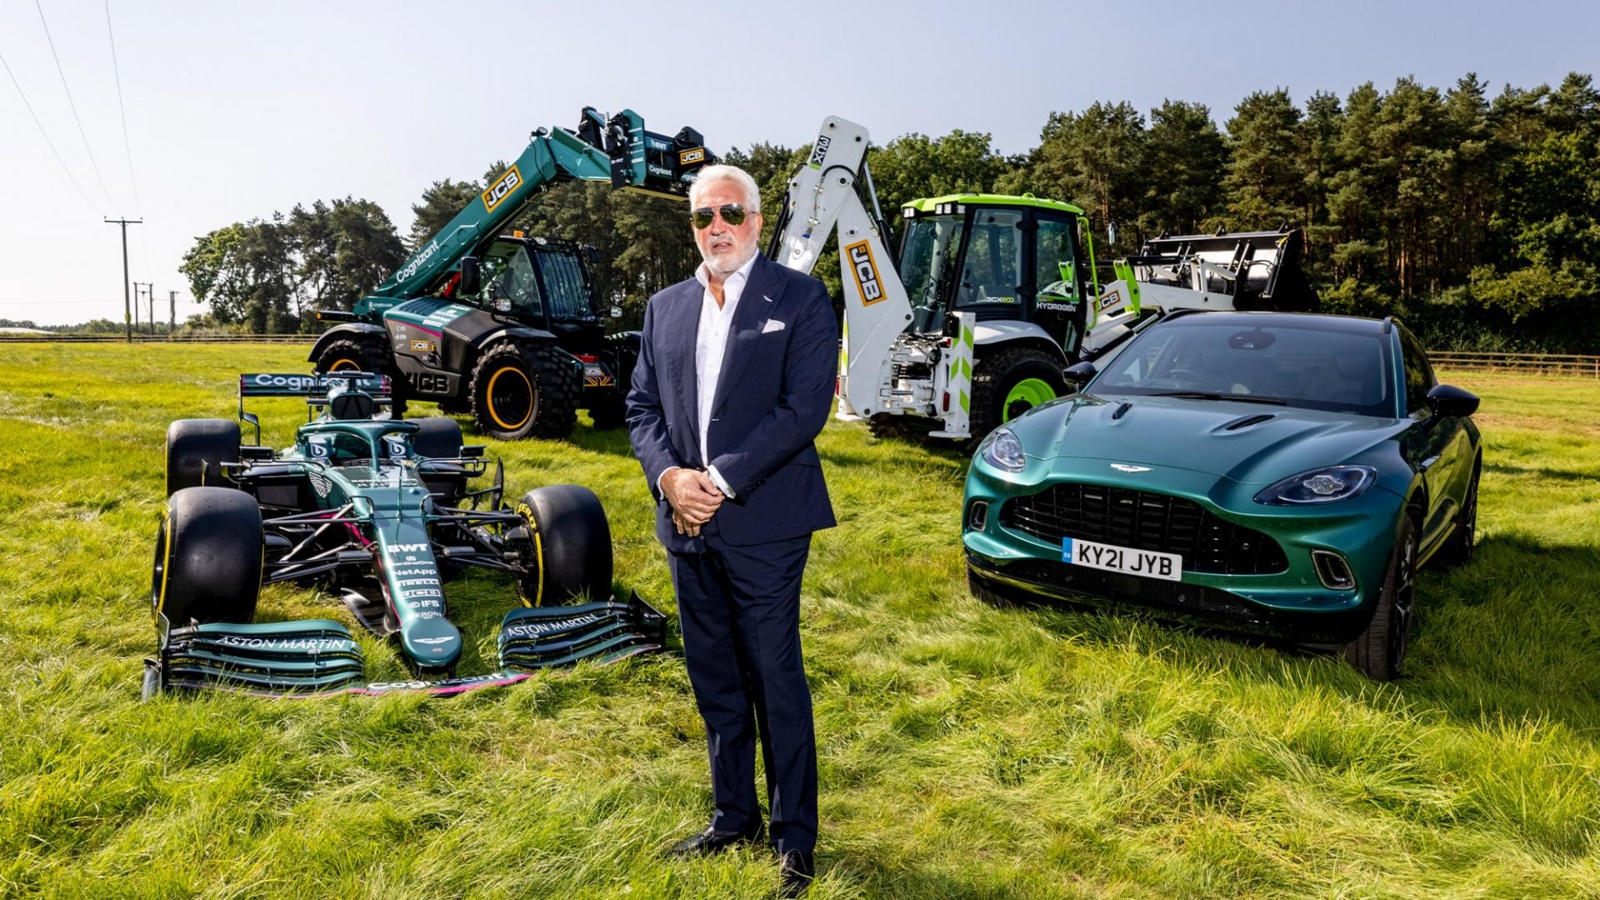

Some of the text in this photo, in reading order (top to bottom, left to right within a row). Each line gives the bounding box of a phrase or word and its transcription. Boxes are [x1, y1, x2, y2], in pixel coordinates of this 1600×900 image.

[682, 151, 702, 162] JCB
[487, 171, 519, 207] JCB
[396, 239, 440, 282] Cognizant
[850, 247, 882, 300] JCB
[1036, 301, 1077, 313] HYDROGEN
[387, 544, 428, 553] BWT
[1078, 543, 1172, 576] KY21 JYB
[393, 568, 437, 576] NetApp
[421, 600, 440, 608] IFS
[508, 613, 600, 637] ASTON MARTIN
[216, 636, 346, 649] ASTON MARTIN
